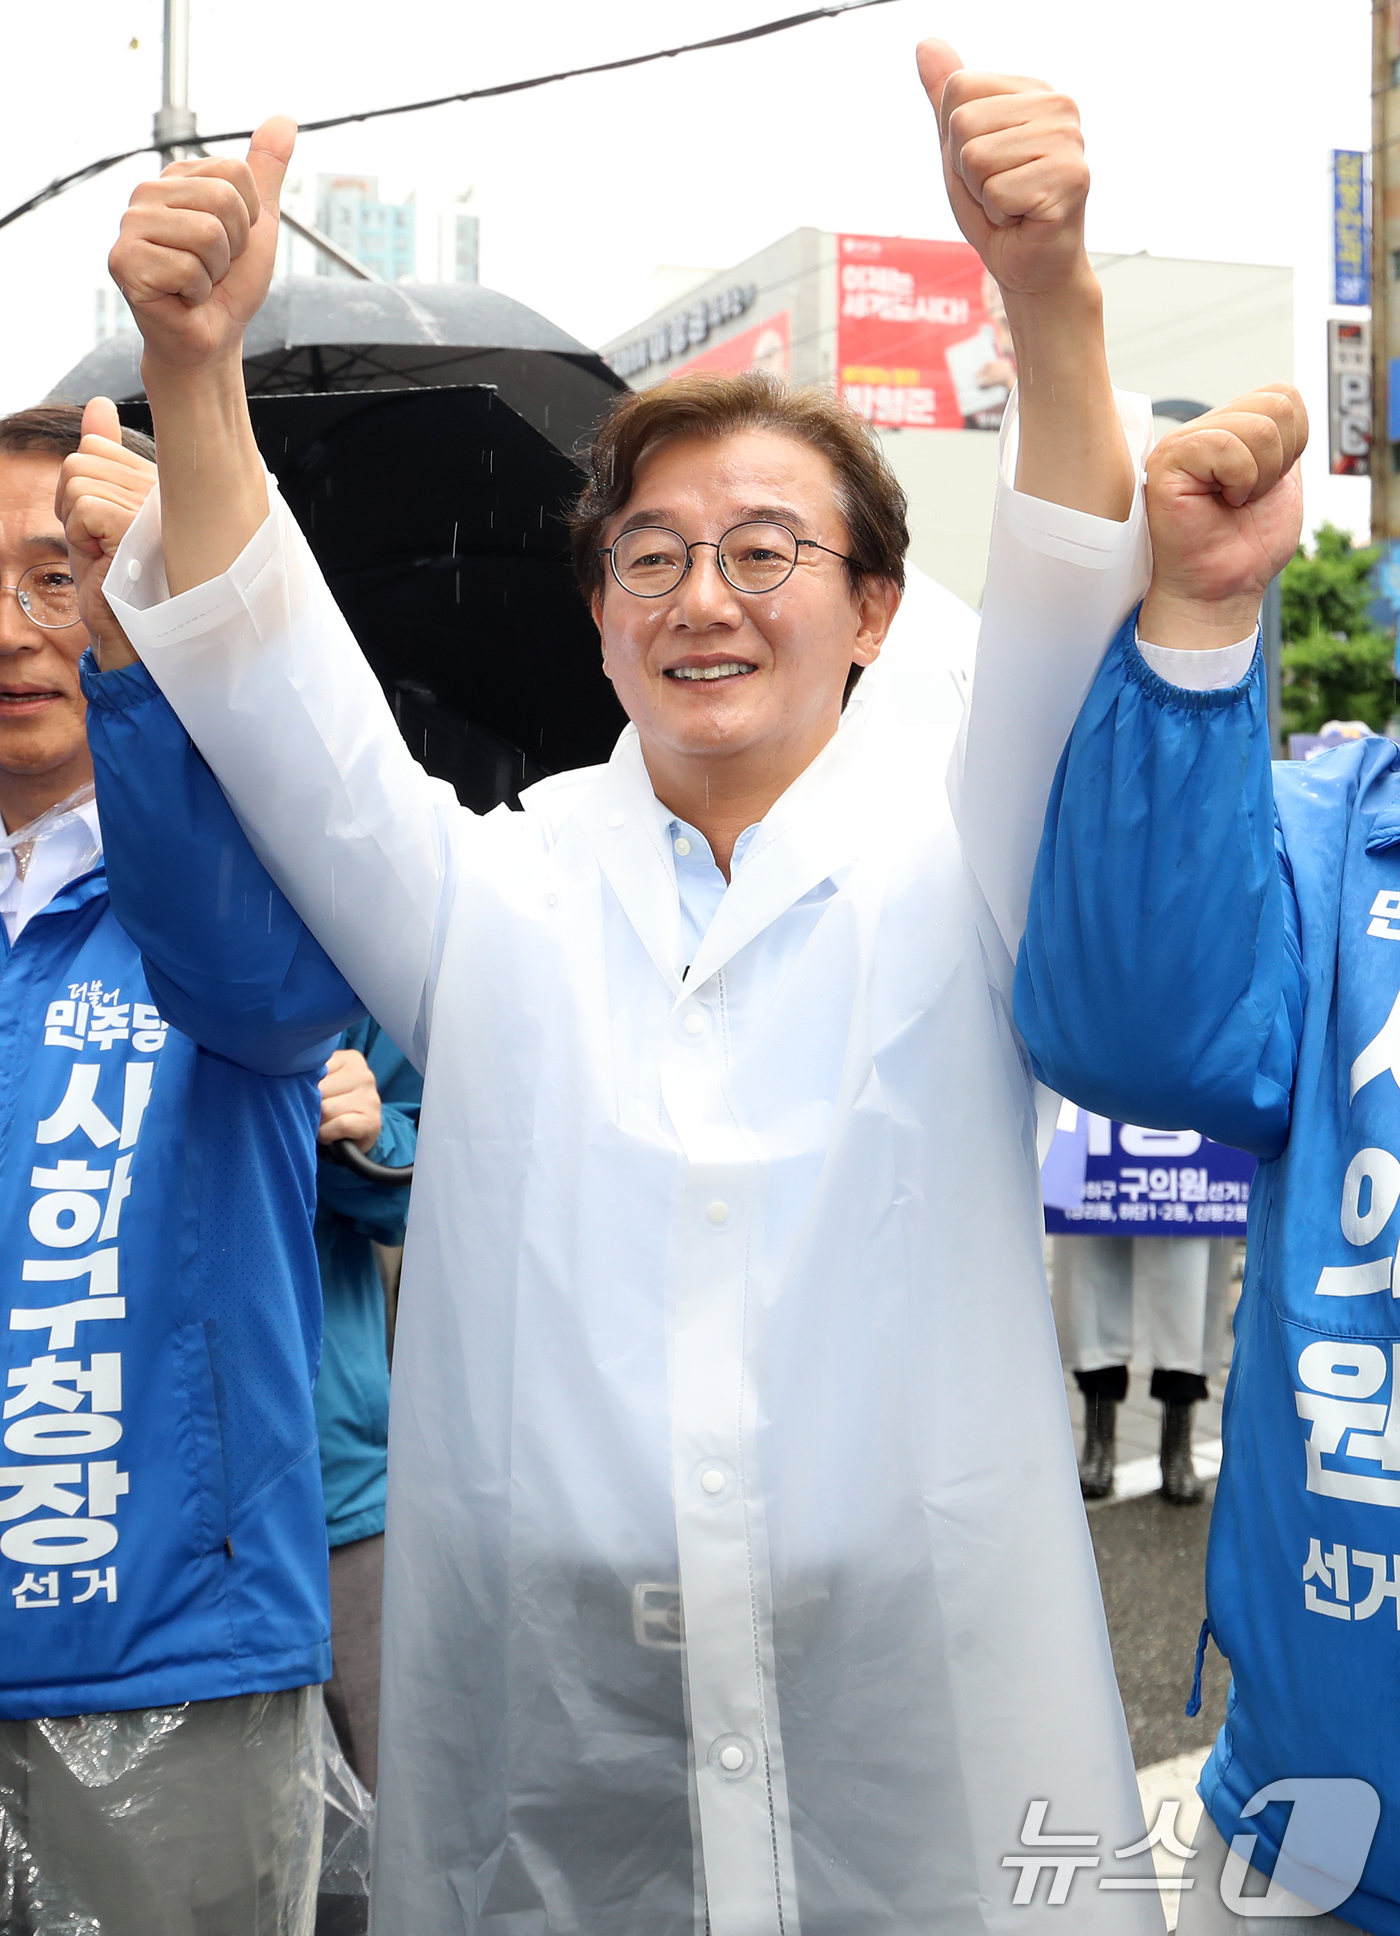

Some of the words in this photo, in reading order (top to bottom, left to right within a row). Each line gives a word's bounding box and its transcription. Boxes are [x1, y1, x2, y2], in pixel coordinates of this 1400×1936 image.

[67, 979, 120, 1008] 더불어
[44, 1000, 170, 1053] 민주당
[1083, 1180, 1118, 1202] 하구
[0, 1061, 155, 1566] 사하구청장
[11, 1566, 117, 1609] 선거
[1302, 1537, 1400, 1631] 선거
